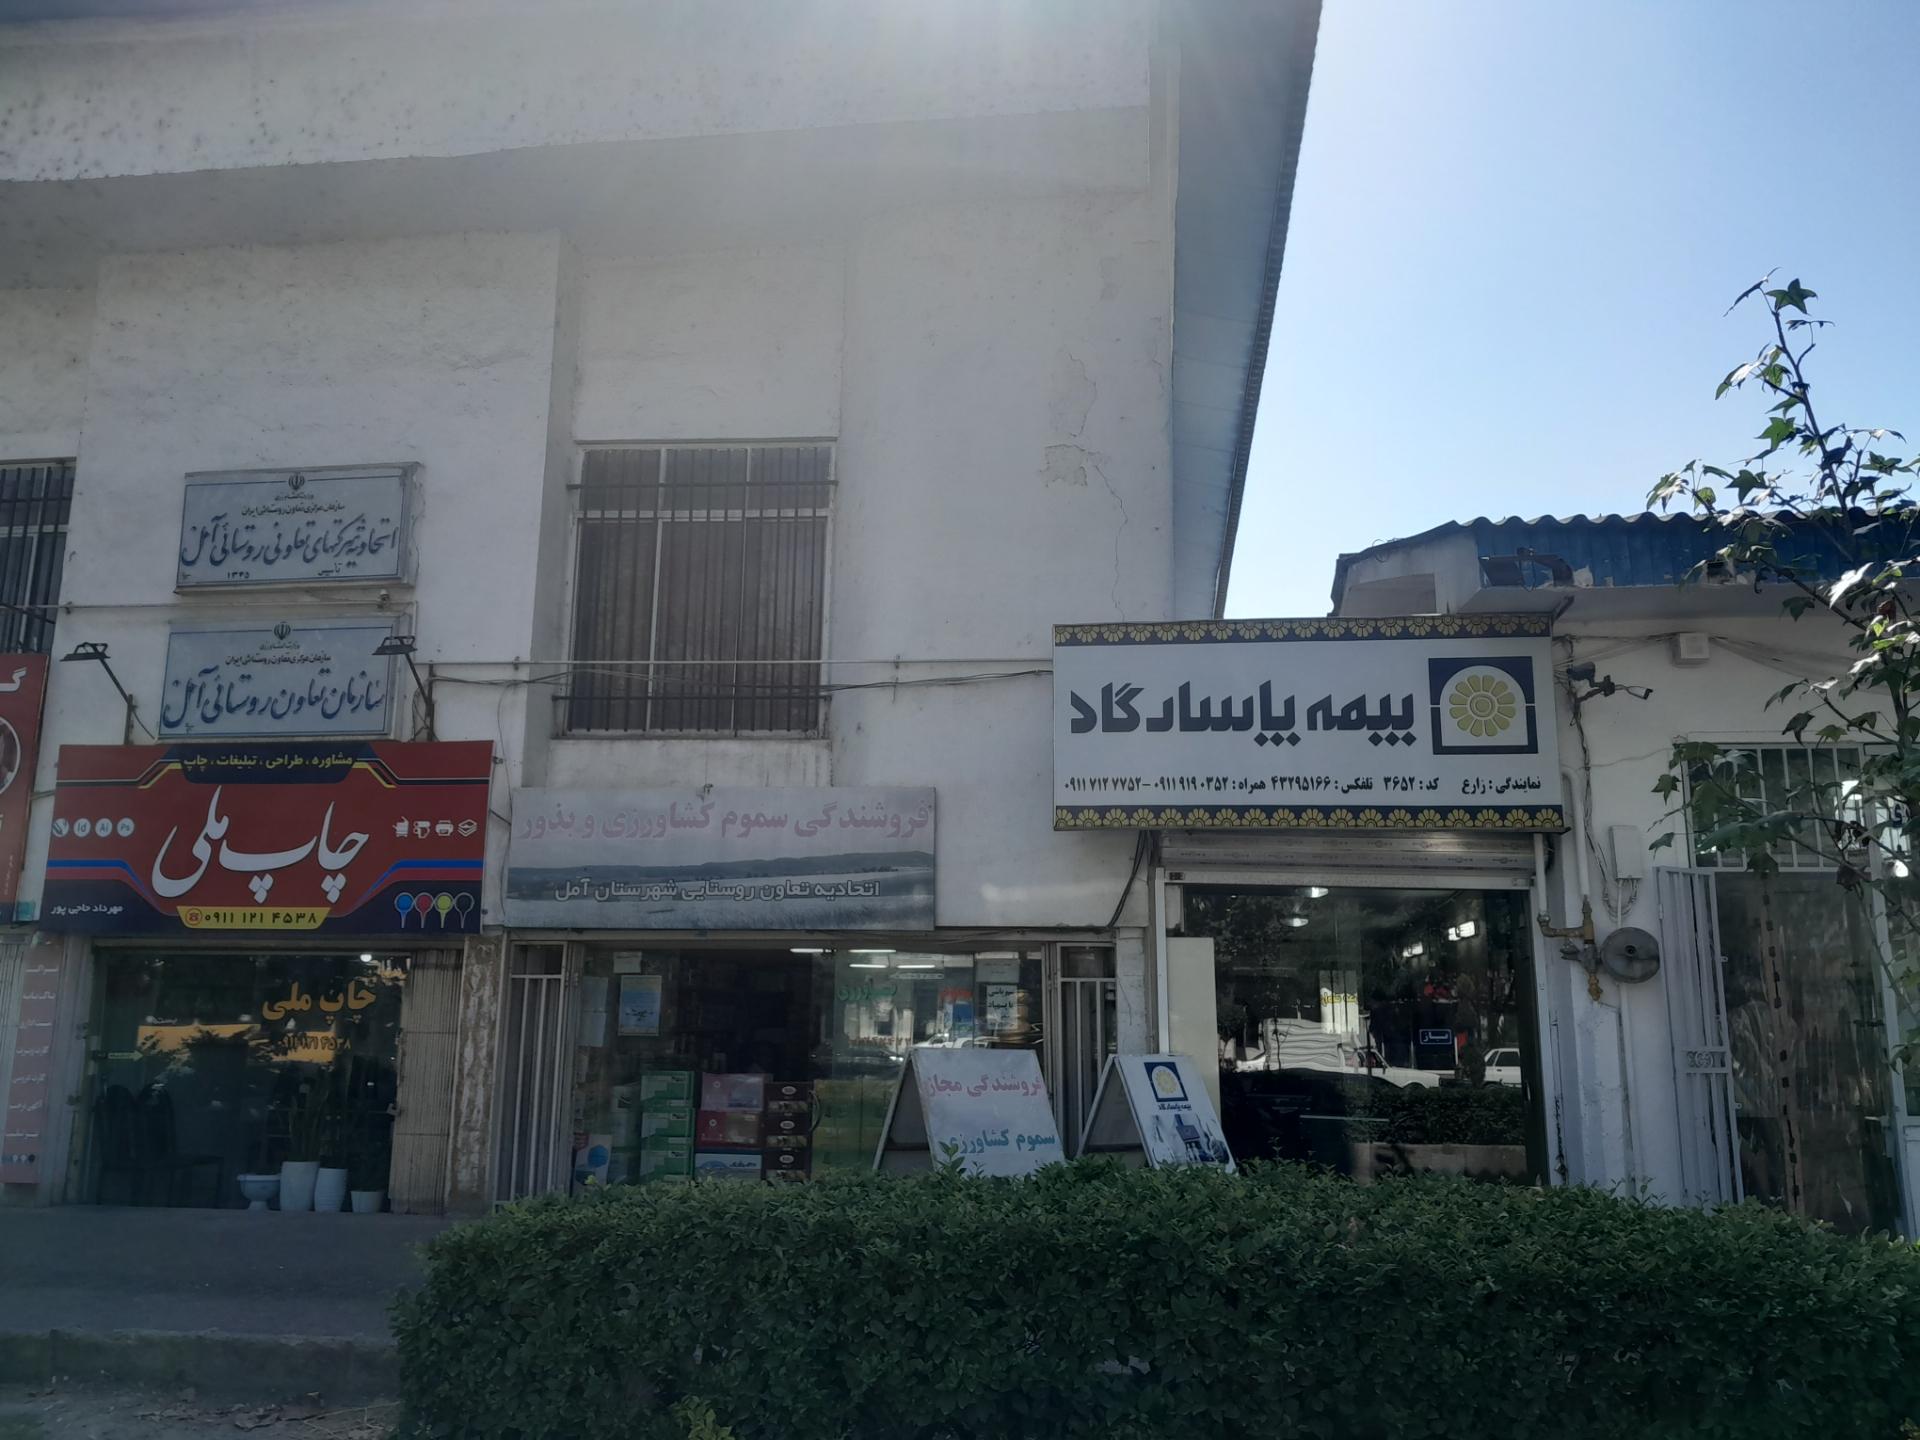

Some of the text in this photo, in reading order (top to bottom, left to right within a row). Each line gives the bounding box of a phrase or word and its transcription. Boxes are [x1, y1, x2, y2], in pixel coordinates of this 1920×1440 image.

[181, 512, 228, 566] آمل
[263, 520, 316, 565] تعاونی
[347, 517, 400, 568] اتحادیه
[162, 665, 219, 728] آمل
[270, 668, 331, 720] تعاون
[322, 670, 385, 719] سازمان
[1070, 680, 1417, 747] بیمه پاسارگاد
[183, 755, 208, 772] چاپ
[1271, 777, 1332, 792] ۴۳۲۹۵۱۶۶
[1383, 777, 1416, 792] ۳۶۵۲
[1461, 777, 1486, 795] زارع
[519, 800, 933, 840] فروشندگی سموم کشاورزی و بذور
[152, 785, 369, 903] چاپ ملی
[50, 904, 123, 916] مهرداد حاجی پور
[554, 878, 880, 901] اتحادیه تعاون روستایی شهرستان آمل
[262, 981, 377, 1024] چاپ ملی
[926, 1073, 1042, 1097] فروشندگی مجاز
[1015, 1132, 1056, 1152] سموم
